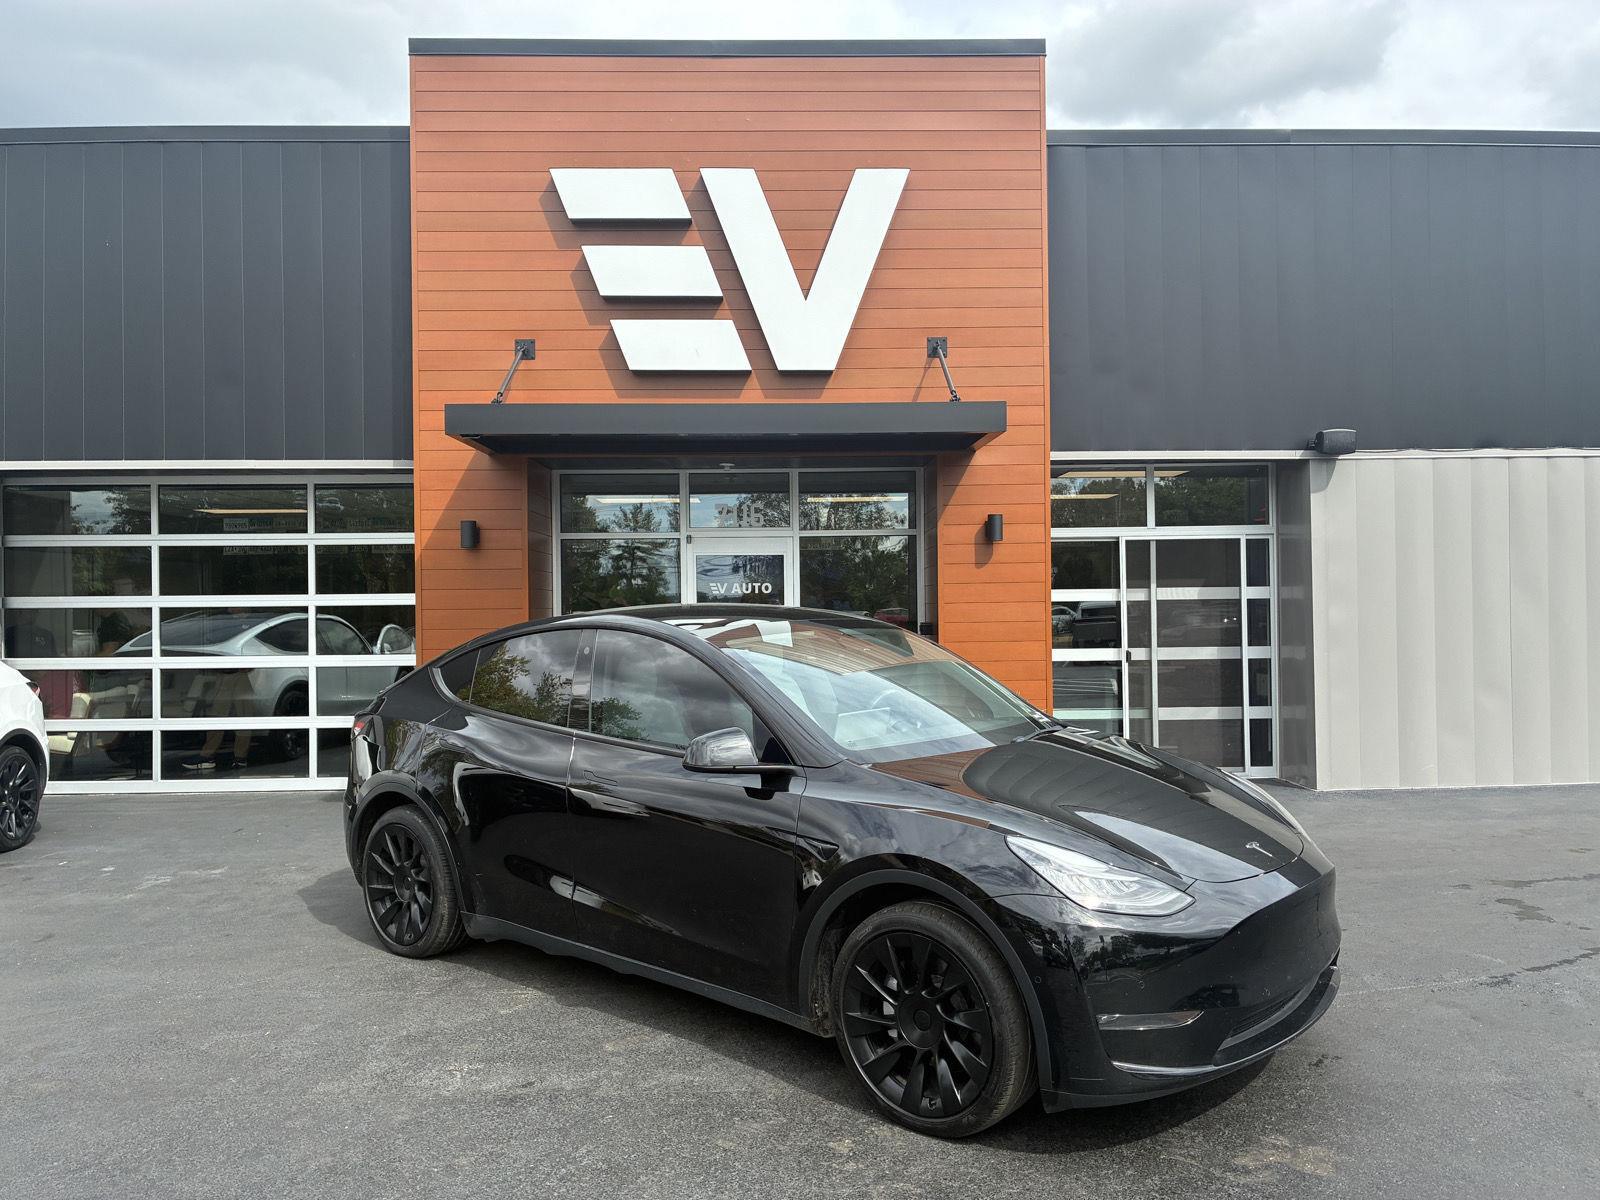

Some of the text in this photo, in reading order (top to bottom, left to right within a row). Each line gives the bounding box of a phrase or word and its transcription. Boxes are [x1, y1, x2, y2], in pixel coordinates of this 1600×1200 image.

[549, 168, 910, 374] EV
[709, 582, 772, 594] EV AUTO
